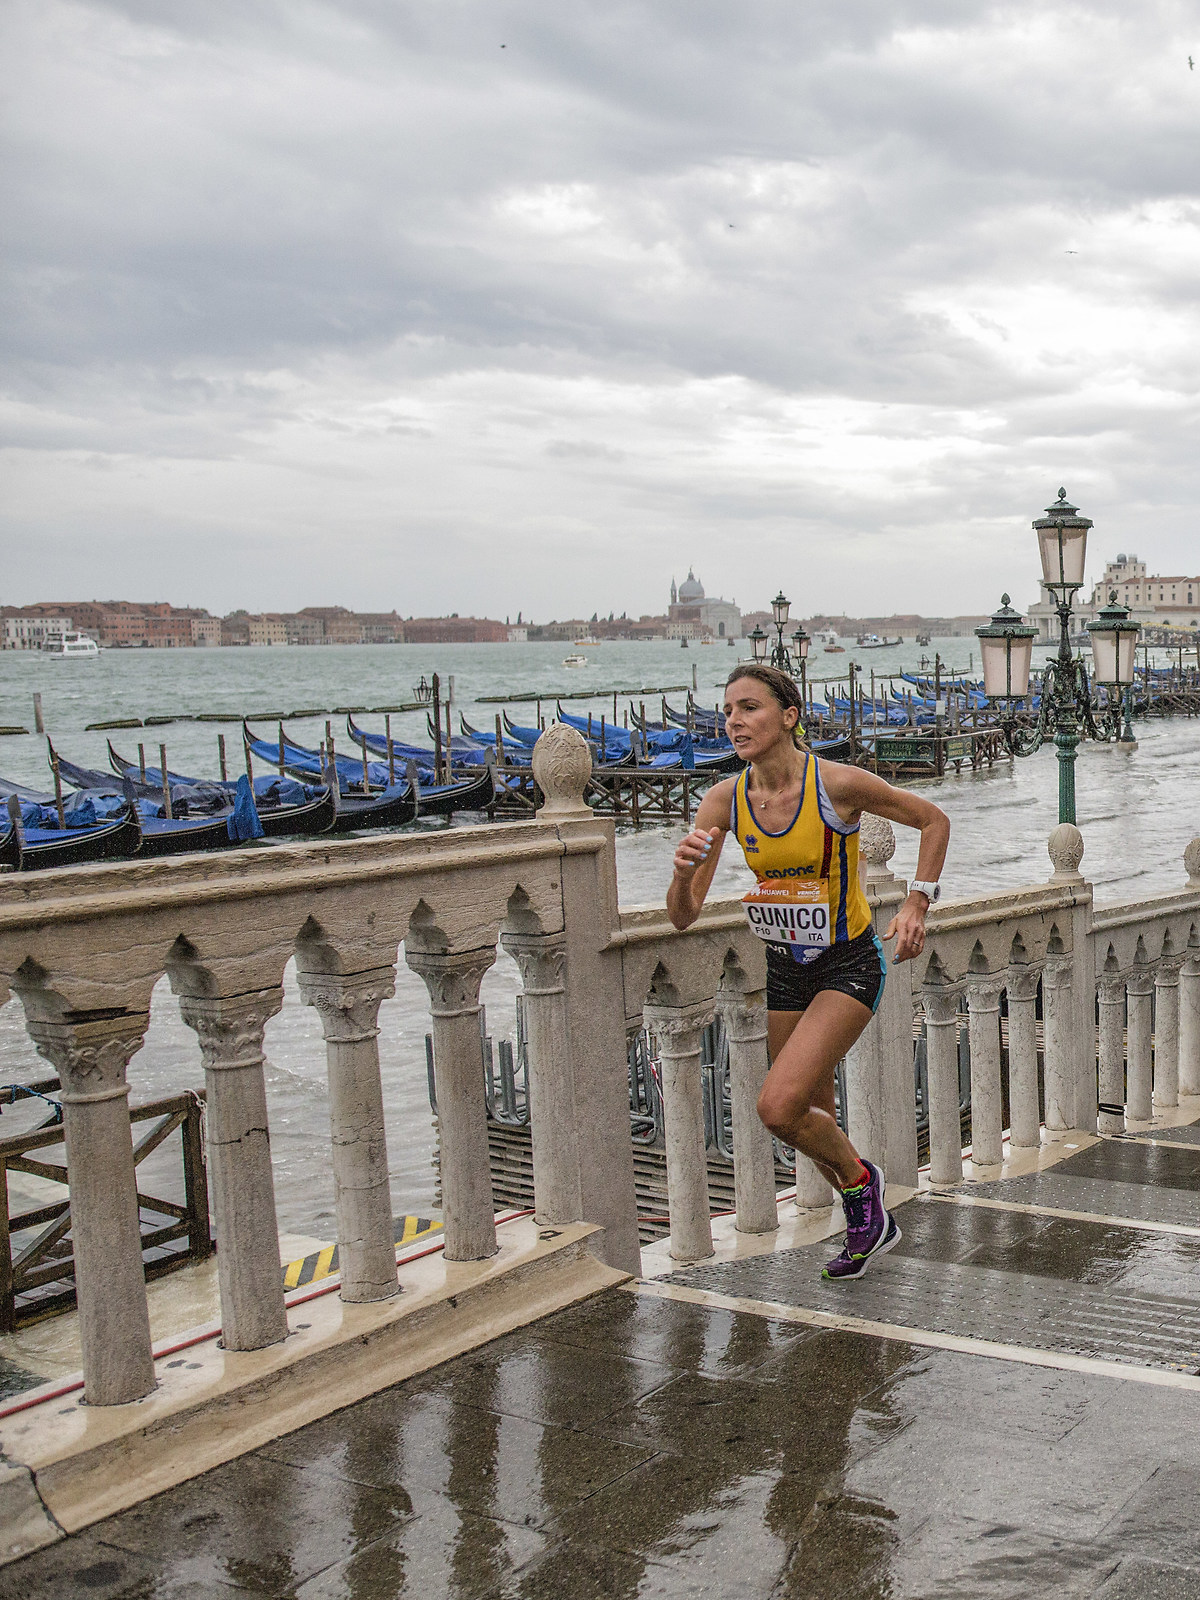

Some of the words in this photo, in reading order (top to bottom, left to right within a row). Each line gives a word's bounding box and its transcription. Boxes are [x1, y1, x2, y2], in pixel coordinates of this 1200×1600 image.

[747, 906, 827, 930] CUNICO
[755, 927, 771, 935] F10
[808, 933, 824, 941] ITA
